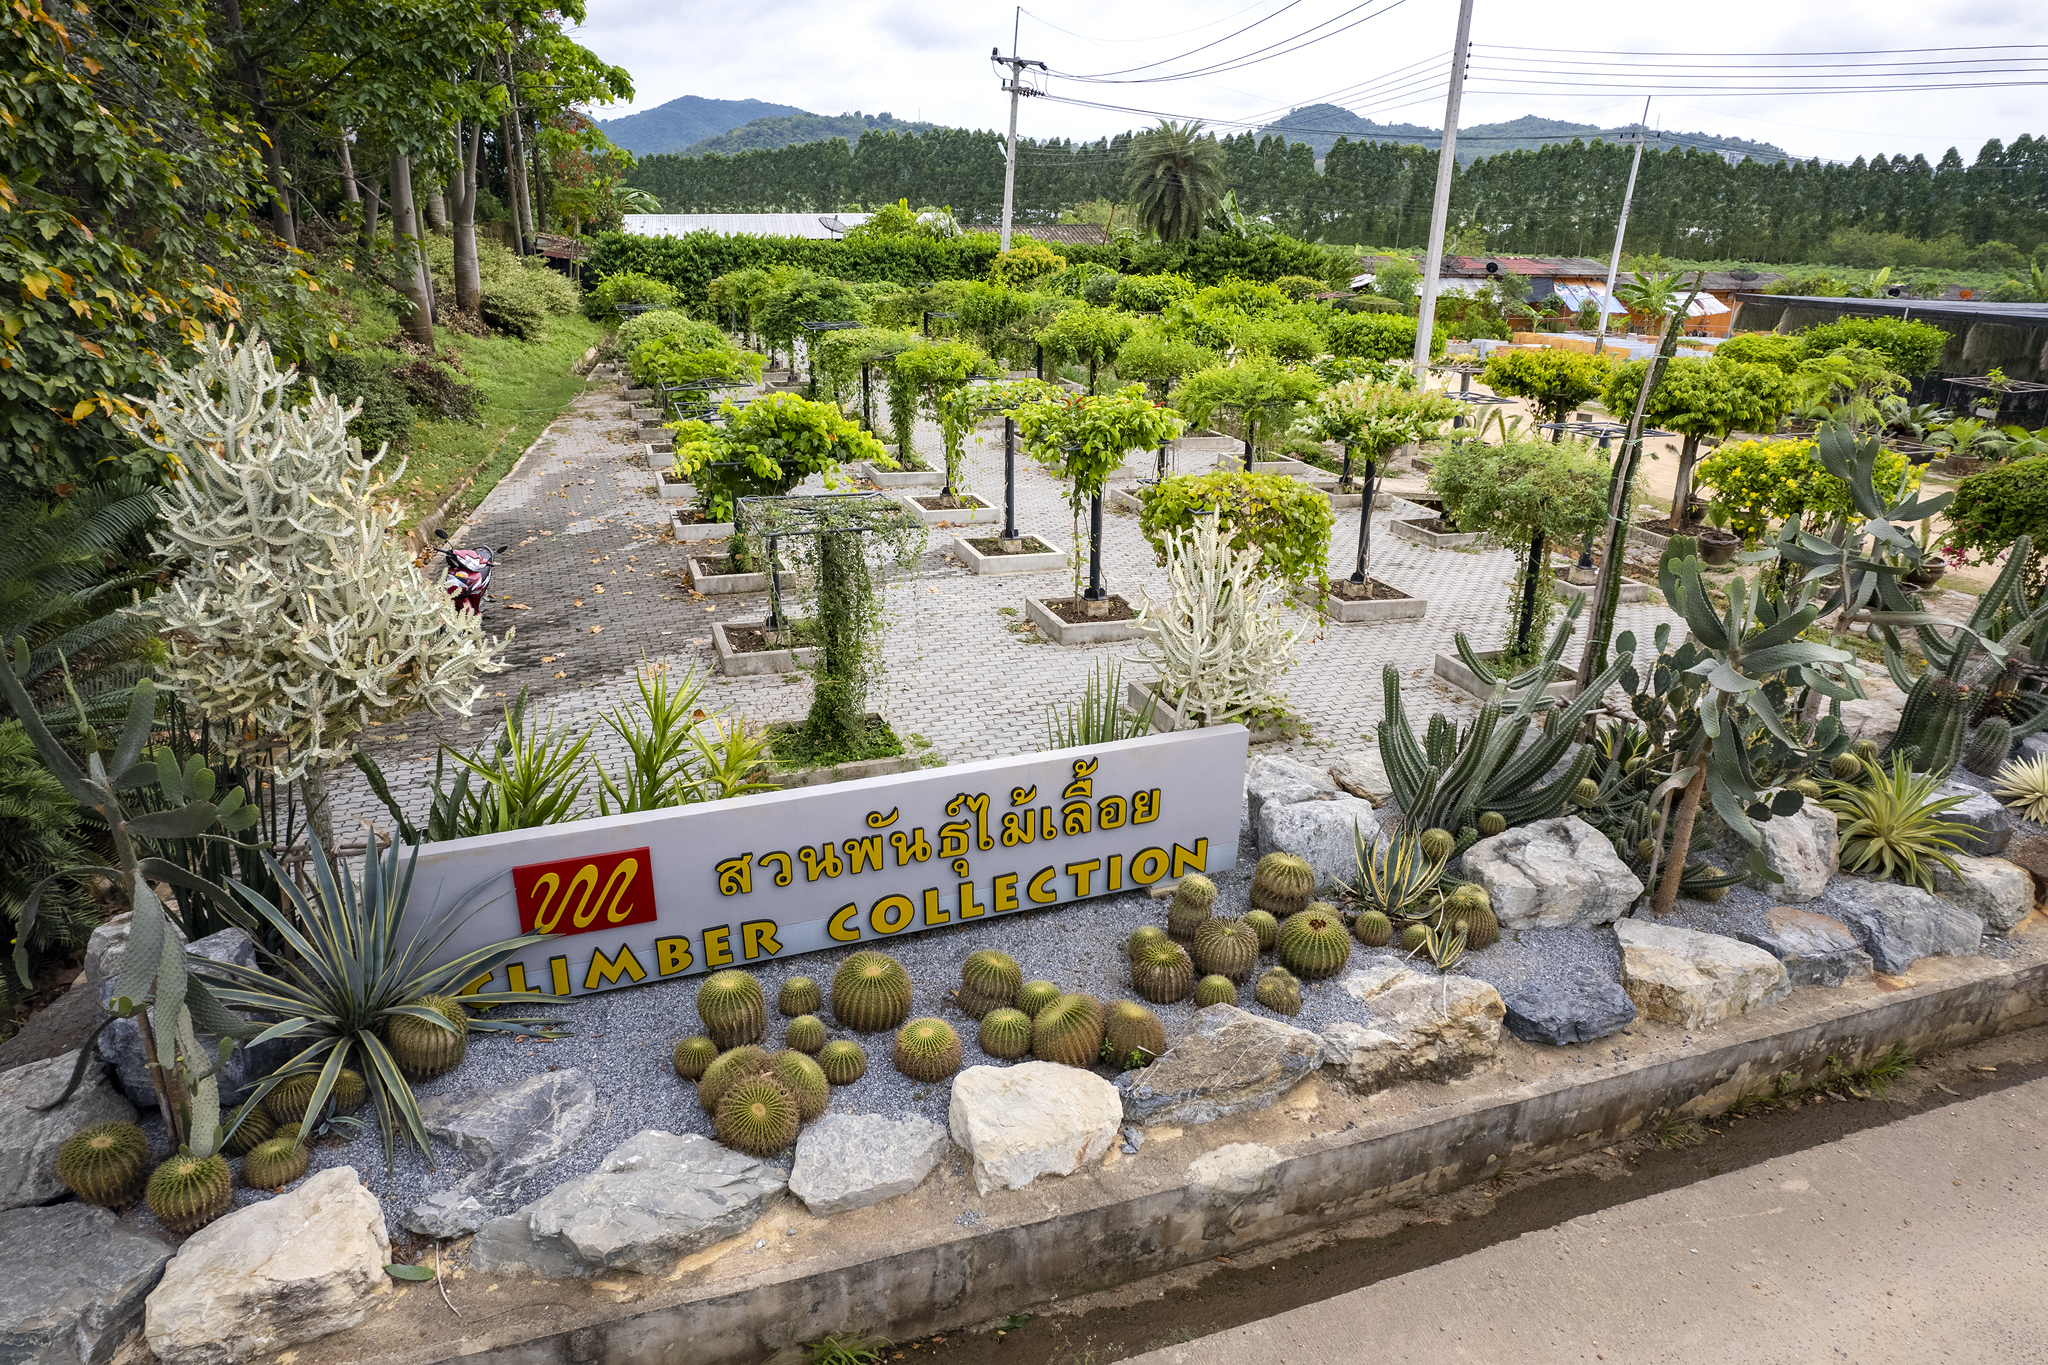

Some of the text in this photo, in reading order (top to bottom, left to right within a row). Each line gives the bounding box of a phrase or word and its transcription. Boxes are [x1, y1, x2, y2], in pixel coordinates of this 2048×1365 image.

[714, 756, 1162, 896] สวนพันธุ์ไม้เลื้อย
[460, 837, 1209, 1010] CLIMBER COLLECTION
